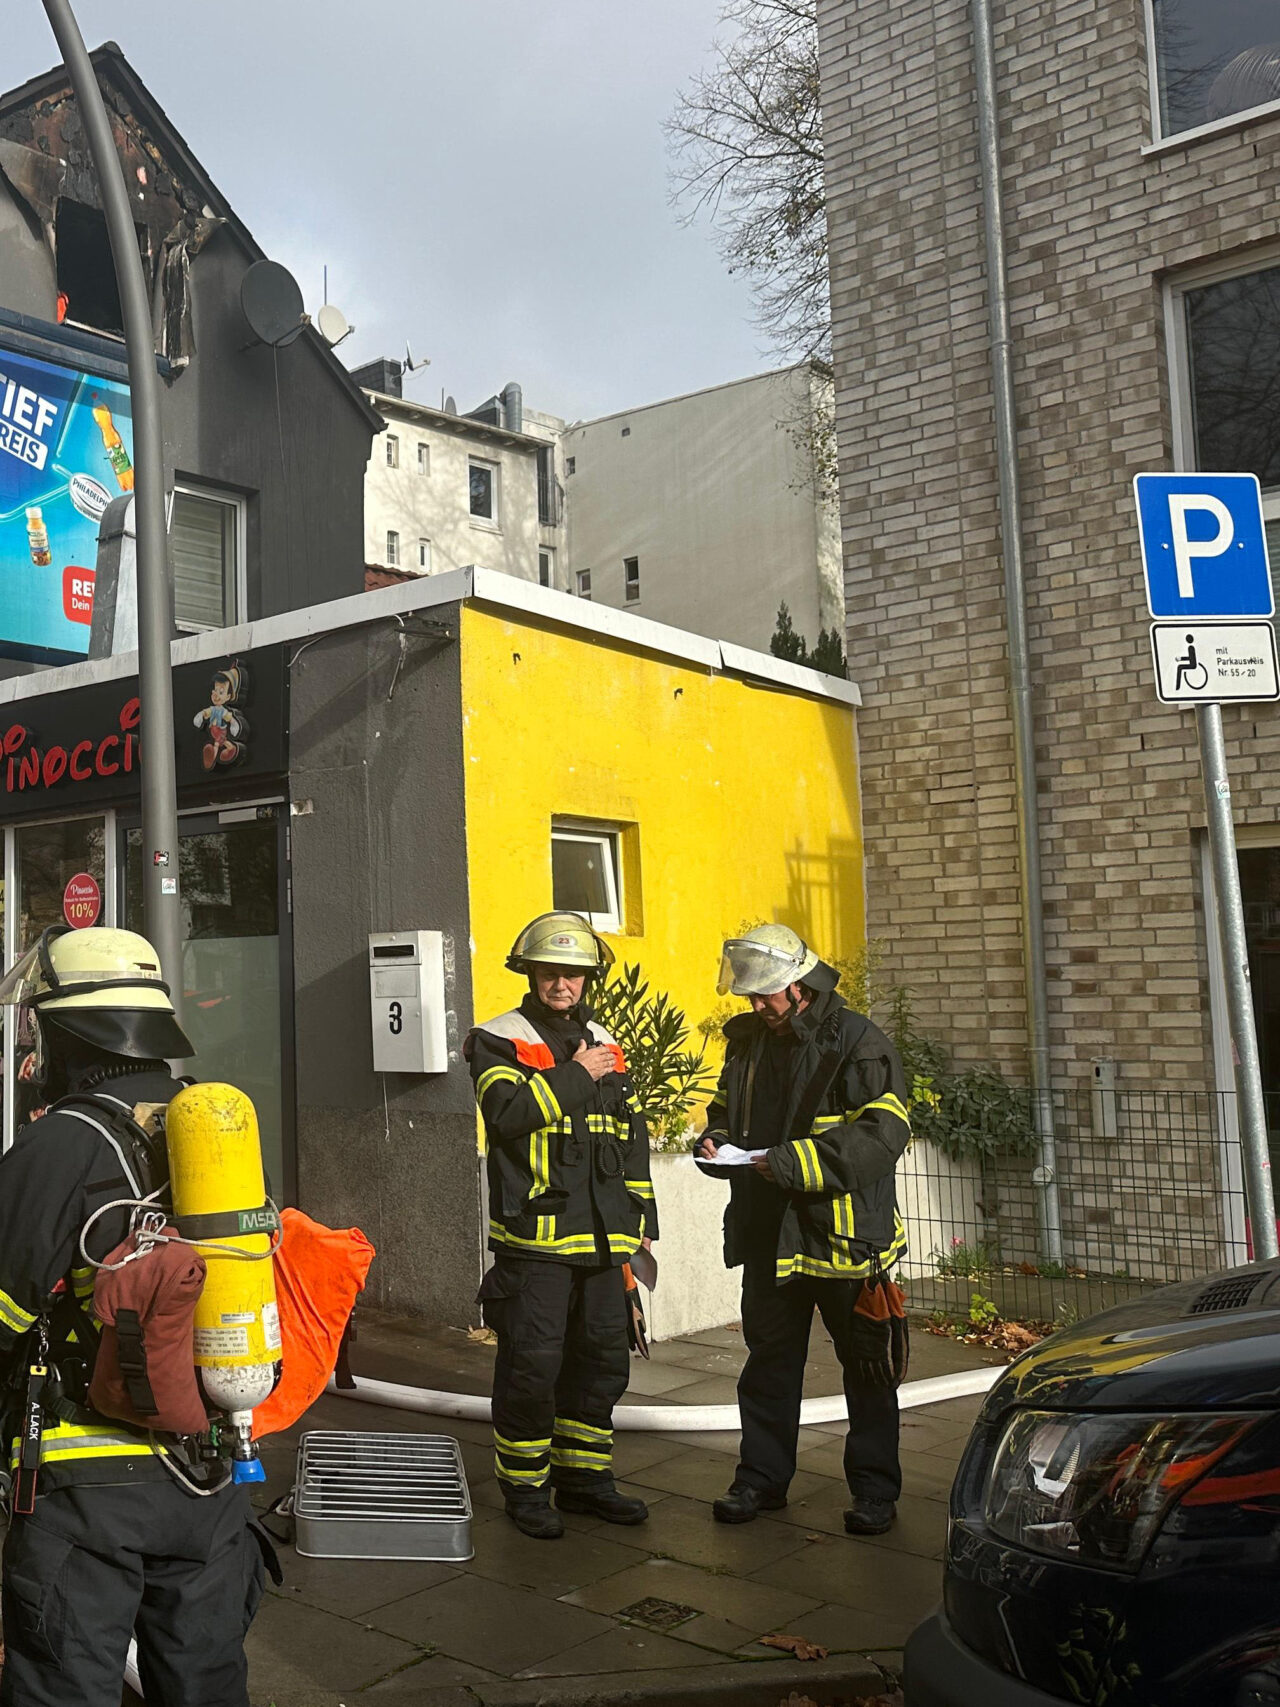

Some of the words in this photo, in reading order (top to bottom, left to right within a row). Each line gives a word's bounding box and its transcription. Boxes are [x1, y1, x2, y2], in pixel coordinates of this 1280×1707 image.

[1168, 494, 1234, 598] P
[72, 579, 95, 597] RE
[72, 598, 90, 611] Dein
[1216, 647, 1228, 655] mit
[1217, 657, 1264, 666] Parkausweis
[1218, 669, 1230, 677] Nr.
[70, 903, 94, 919] 10%
[389, 1001, 402, 1035] 3
[242, 1211, 277, 1229] MSA
[31, 1401, 41, 1412] A.
[28, 1414, 40, 1440] LACK
